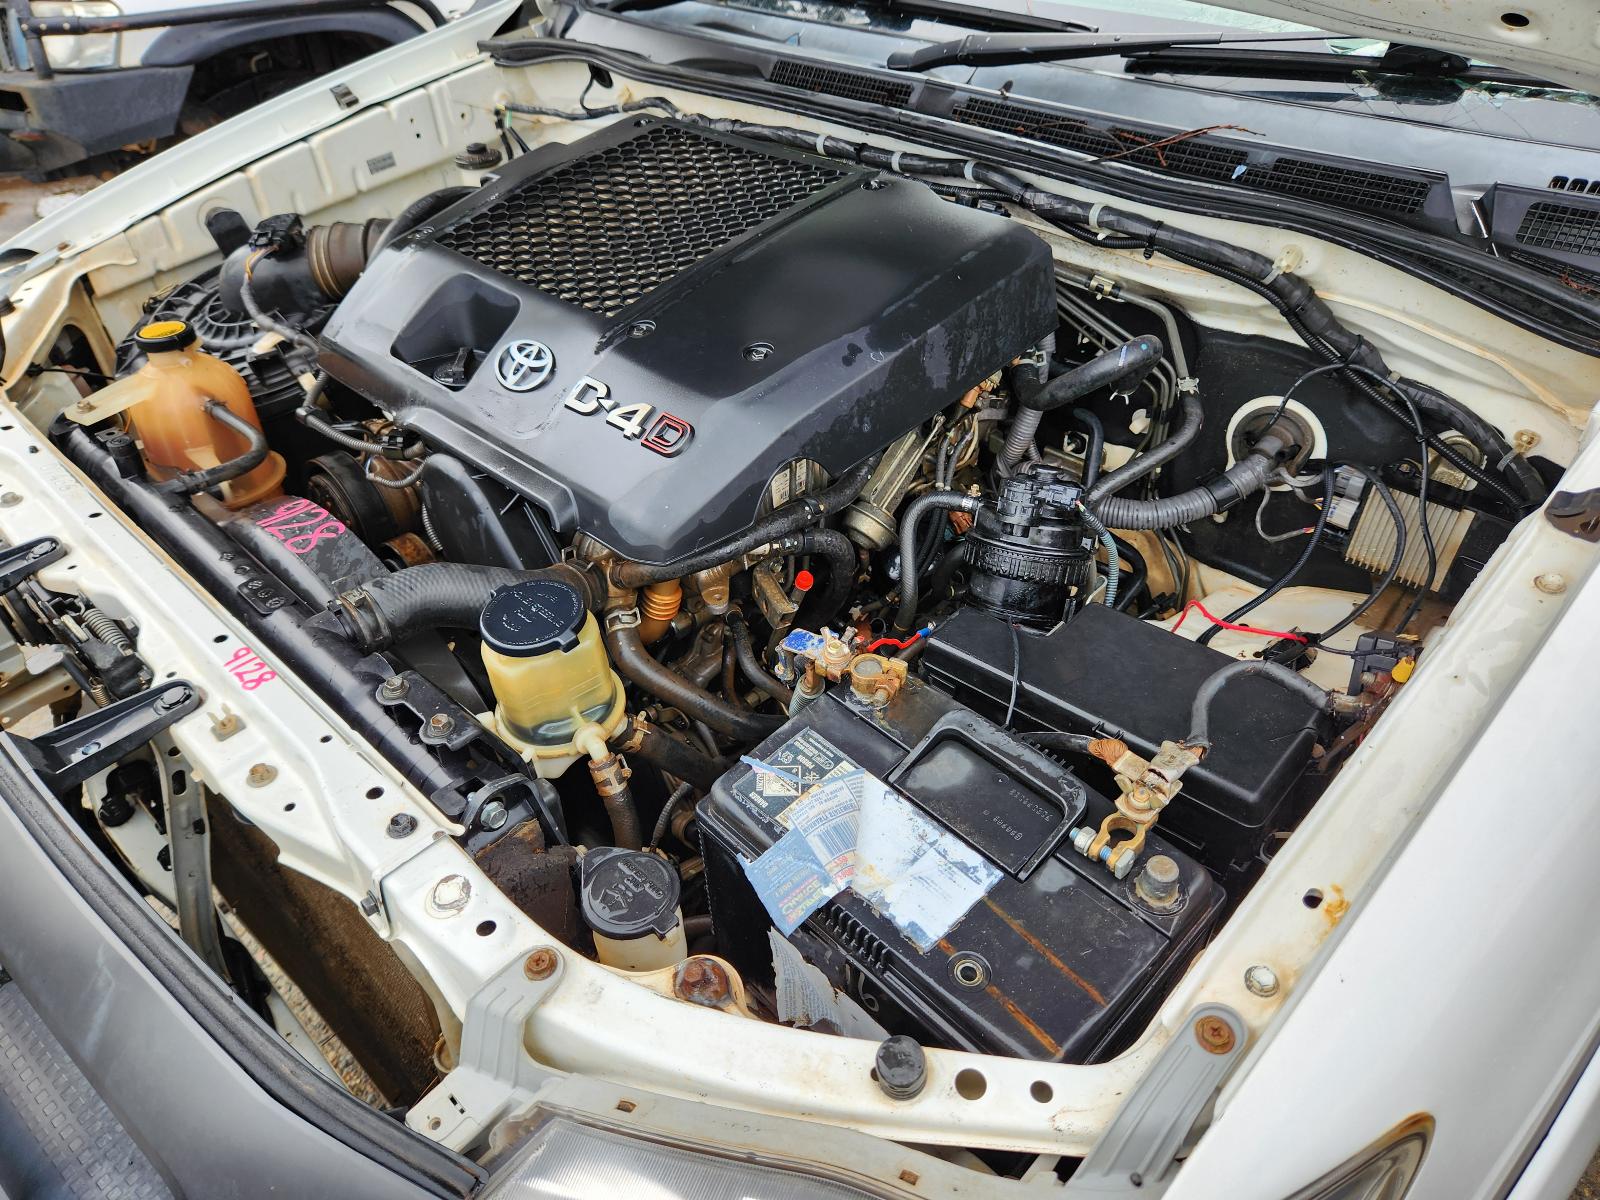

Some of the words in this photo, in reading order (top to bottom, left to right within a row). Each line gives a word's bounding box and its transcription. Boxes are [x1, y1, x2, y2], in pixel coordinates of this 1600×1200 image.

[255, 498, 346, 552] 9128
[224, 646, 277, 690] 9128
[748, 790, 769, 809] DANGER
